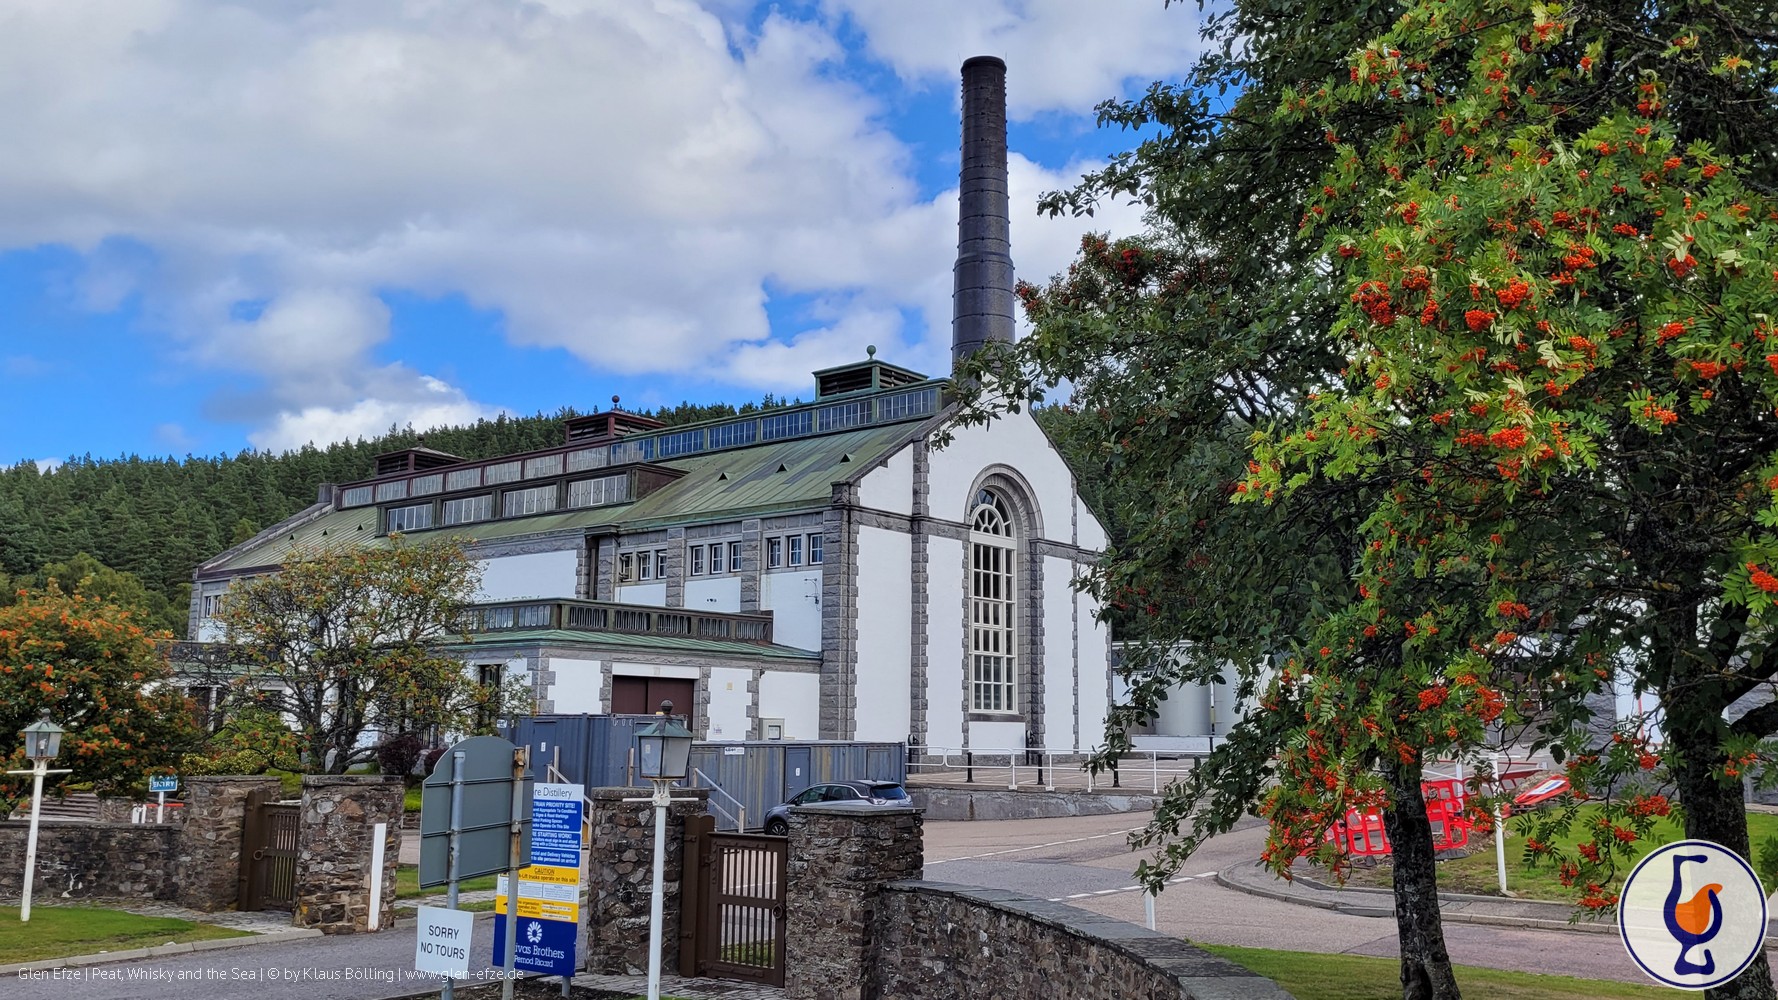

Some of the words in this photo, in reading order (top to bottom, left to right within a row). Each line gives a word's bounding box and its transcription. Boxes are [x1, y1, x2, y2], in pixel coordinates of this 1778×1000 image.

[543, 787, 573, 800] Distillery
[428, 924, 460, 940] SORRY
[420, 941, 433, 954] NO
[435, 944, 465, 960] TOURS
[515, 942, 532, 955] ivas
[533, 944, 565, 960] Brothers
[514, 954, 534, 965] Pernod
[534, 957, 554, 968] Ricard
